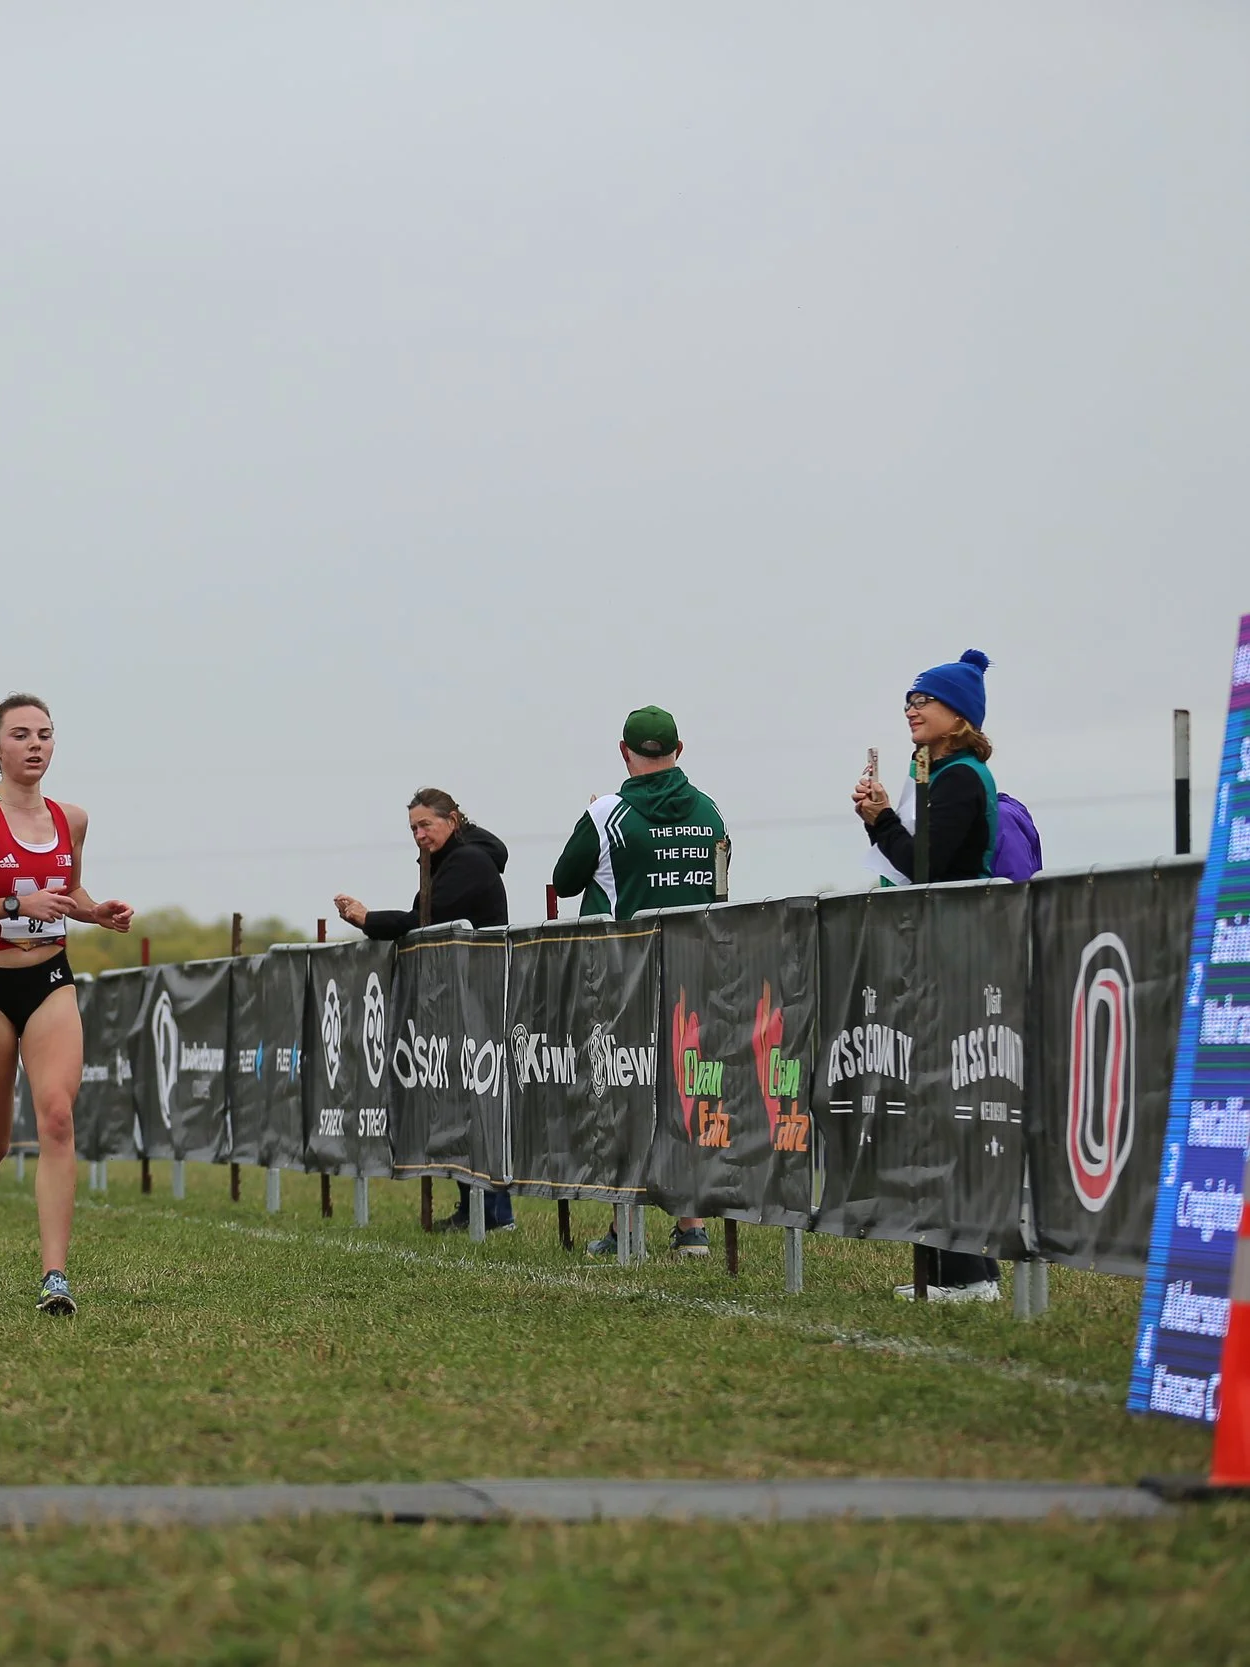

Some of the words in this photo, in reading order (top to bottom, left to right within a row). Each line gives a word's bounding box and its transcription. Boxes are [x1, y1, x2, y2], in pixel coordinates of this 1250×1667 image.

[648, 827, 673, 838] THE
[675, 825, 713, 837] PROUD
[654, 848, 680, 860] THE
[682, 847, 709, 859] FEW
[646, 871, 680, 888] THE
[683, 870, 713, 885] 402
[28, 918, 44, 934] 82
[951, 1026, 986, 1091] CASS
